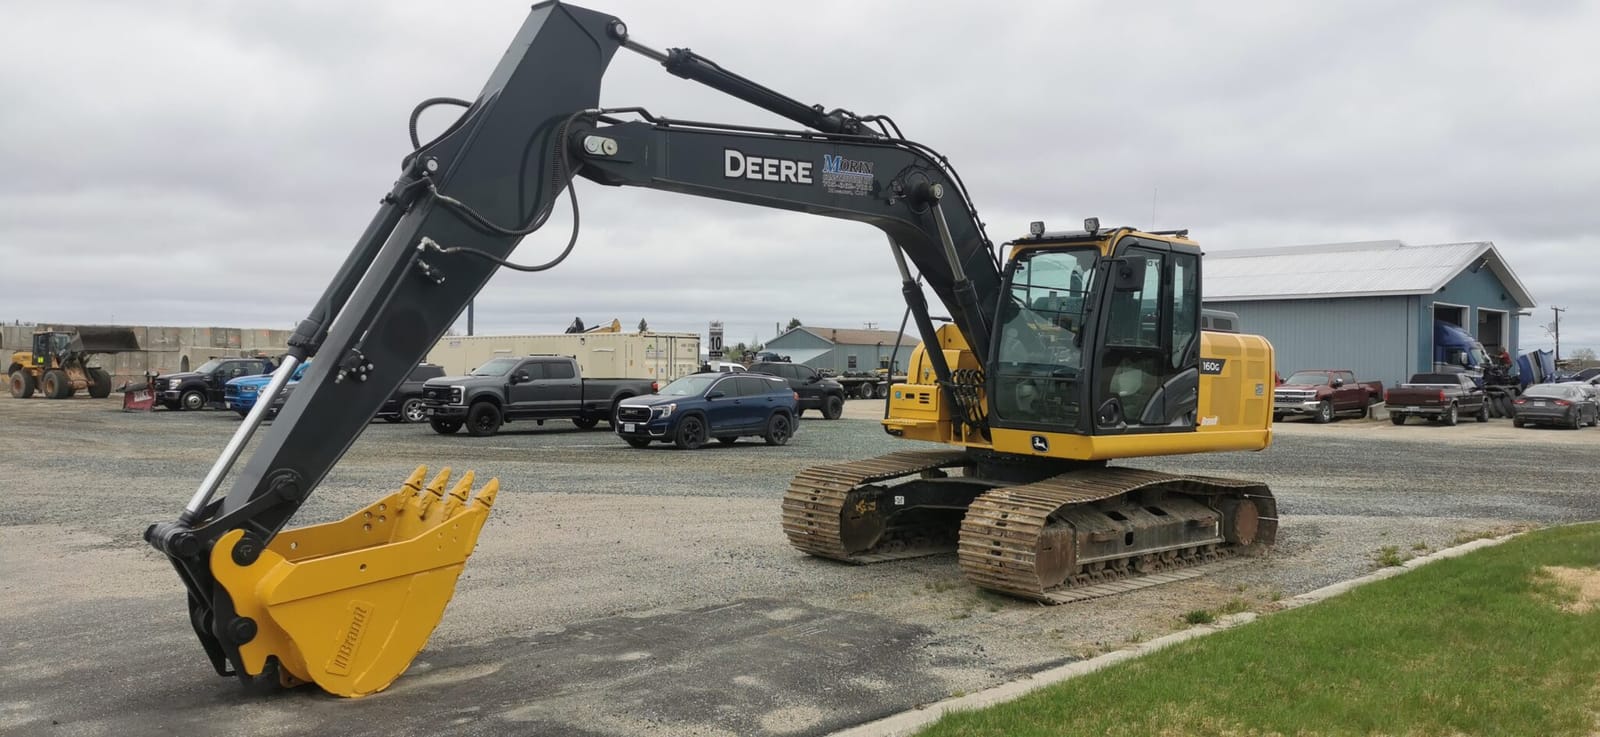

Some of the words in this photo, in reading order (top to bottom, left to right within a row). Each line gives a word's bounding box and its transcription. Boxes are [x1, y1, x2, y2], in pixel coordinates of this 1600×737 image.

[725, 149, 813, 184] DEERE
[822, 154, 873, 173] MORIN
[710, 336, 722, 351] 10
[1202, 361, 1220, 371] 160G
